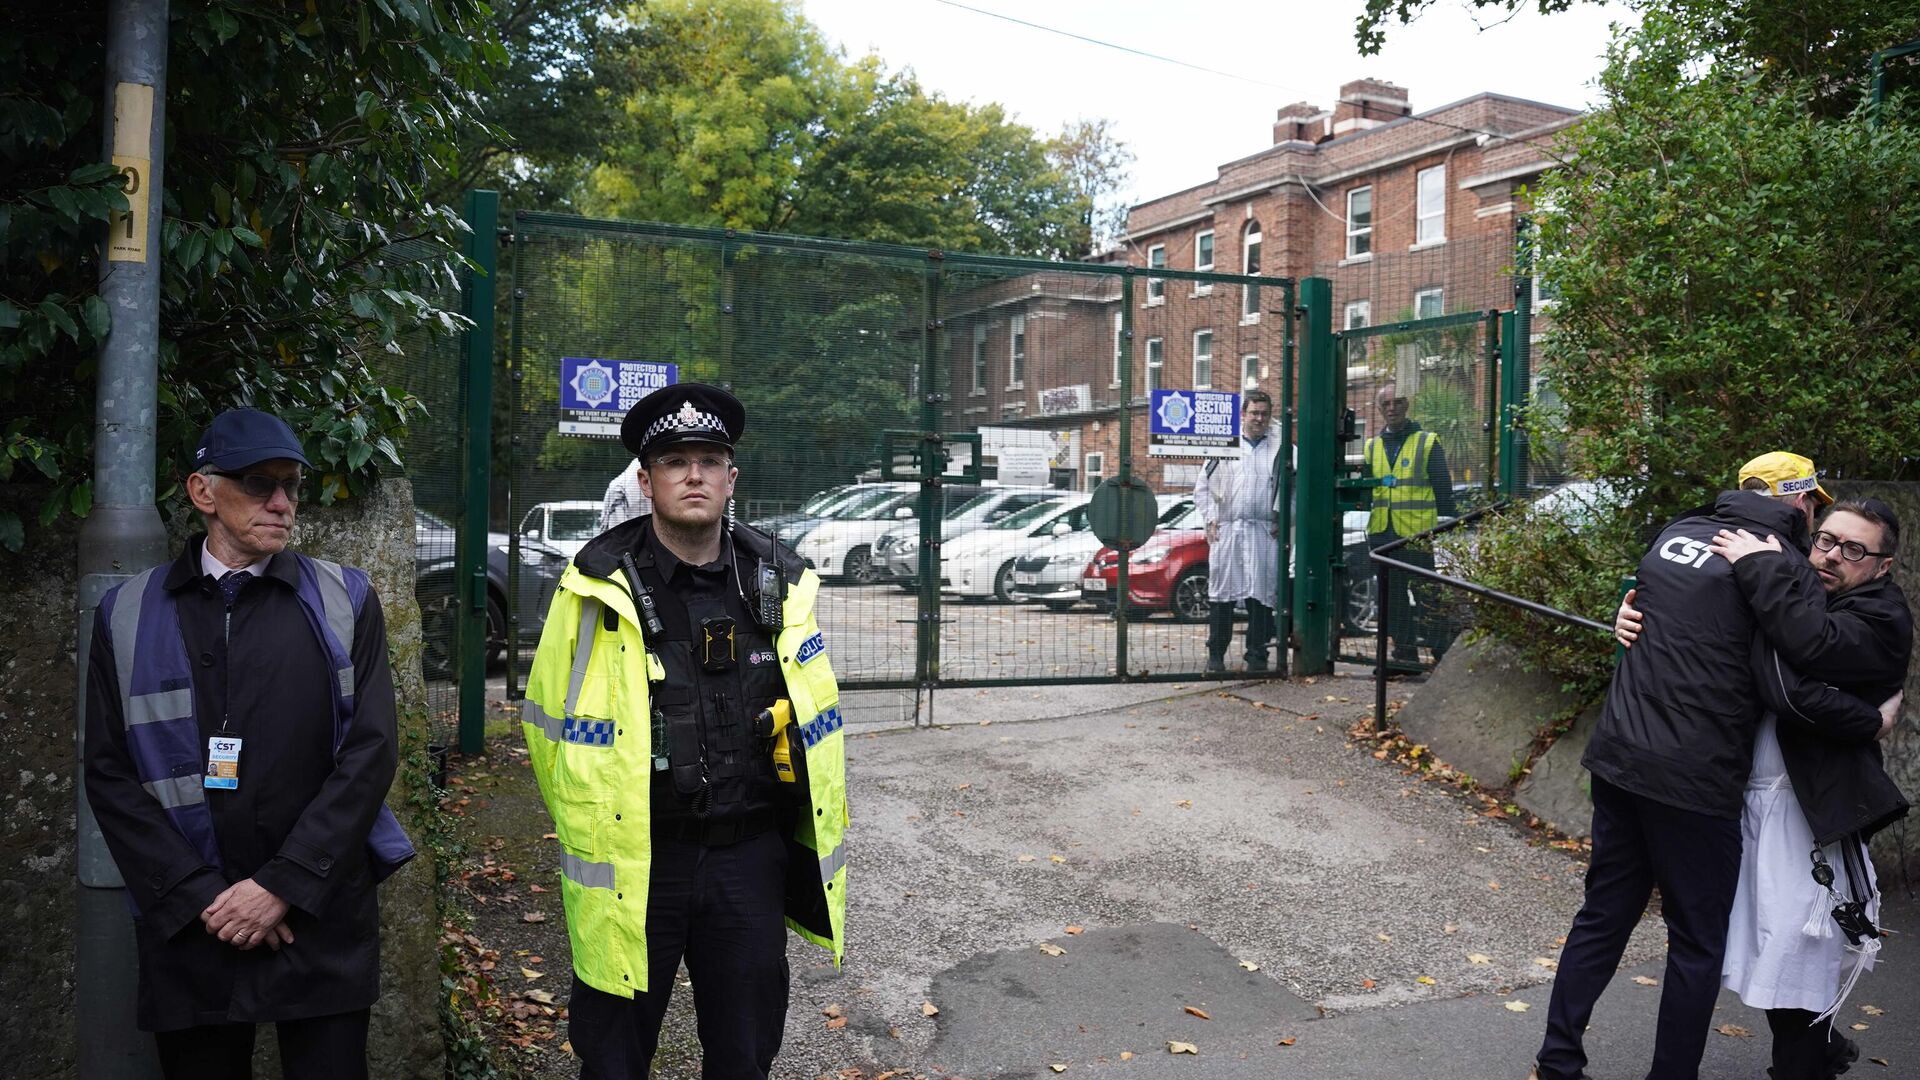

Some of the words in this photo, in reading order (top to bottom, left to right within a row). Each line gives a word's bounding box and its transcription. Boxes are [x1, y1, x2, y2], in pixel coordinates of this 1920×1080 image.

[619, 362, 657, 373] PROTECTED
[657, 365, 668, 374] BY
[618, 371, 668, 387] SECTOR
[618, 385, 660, 399] SECUR
[1194, 400, 1233, 414] SECTOR
[1194, 412, 1233, 425] SECURITY
[1194, 423, 1233, 435] SERVICES
[1782, 476, 1816, 492] SECURITY
[1660, 536, 1714, 569] CST
